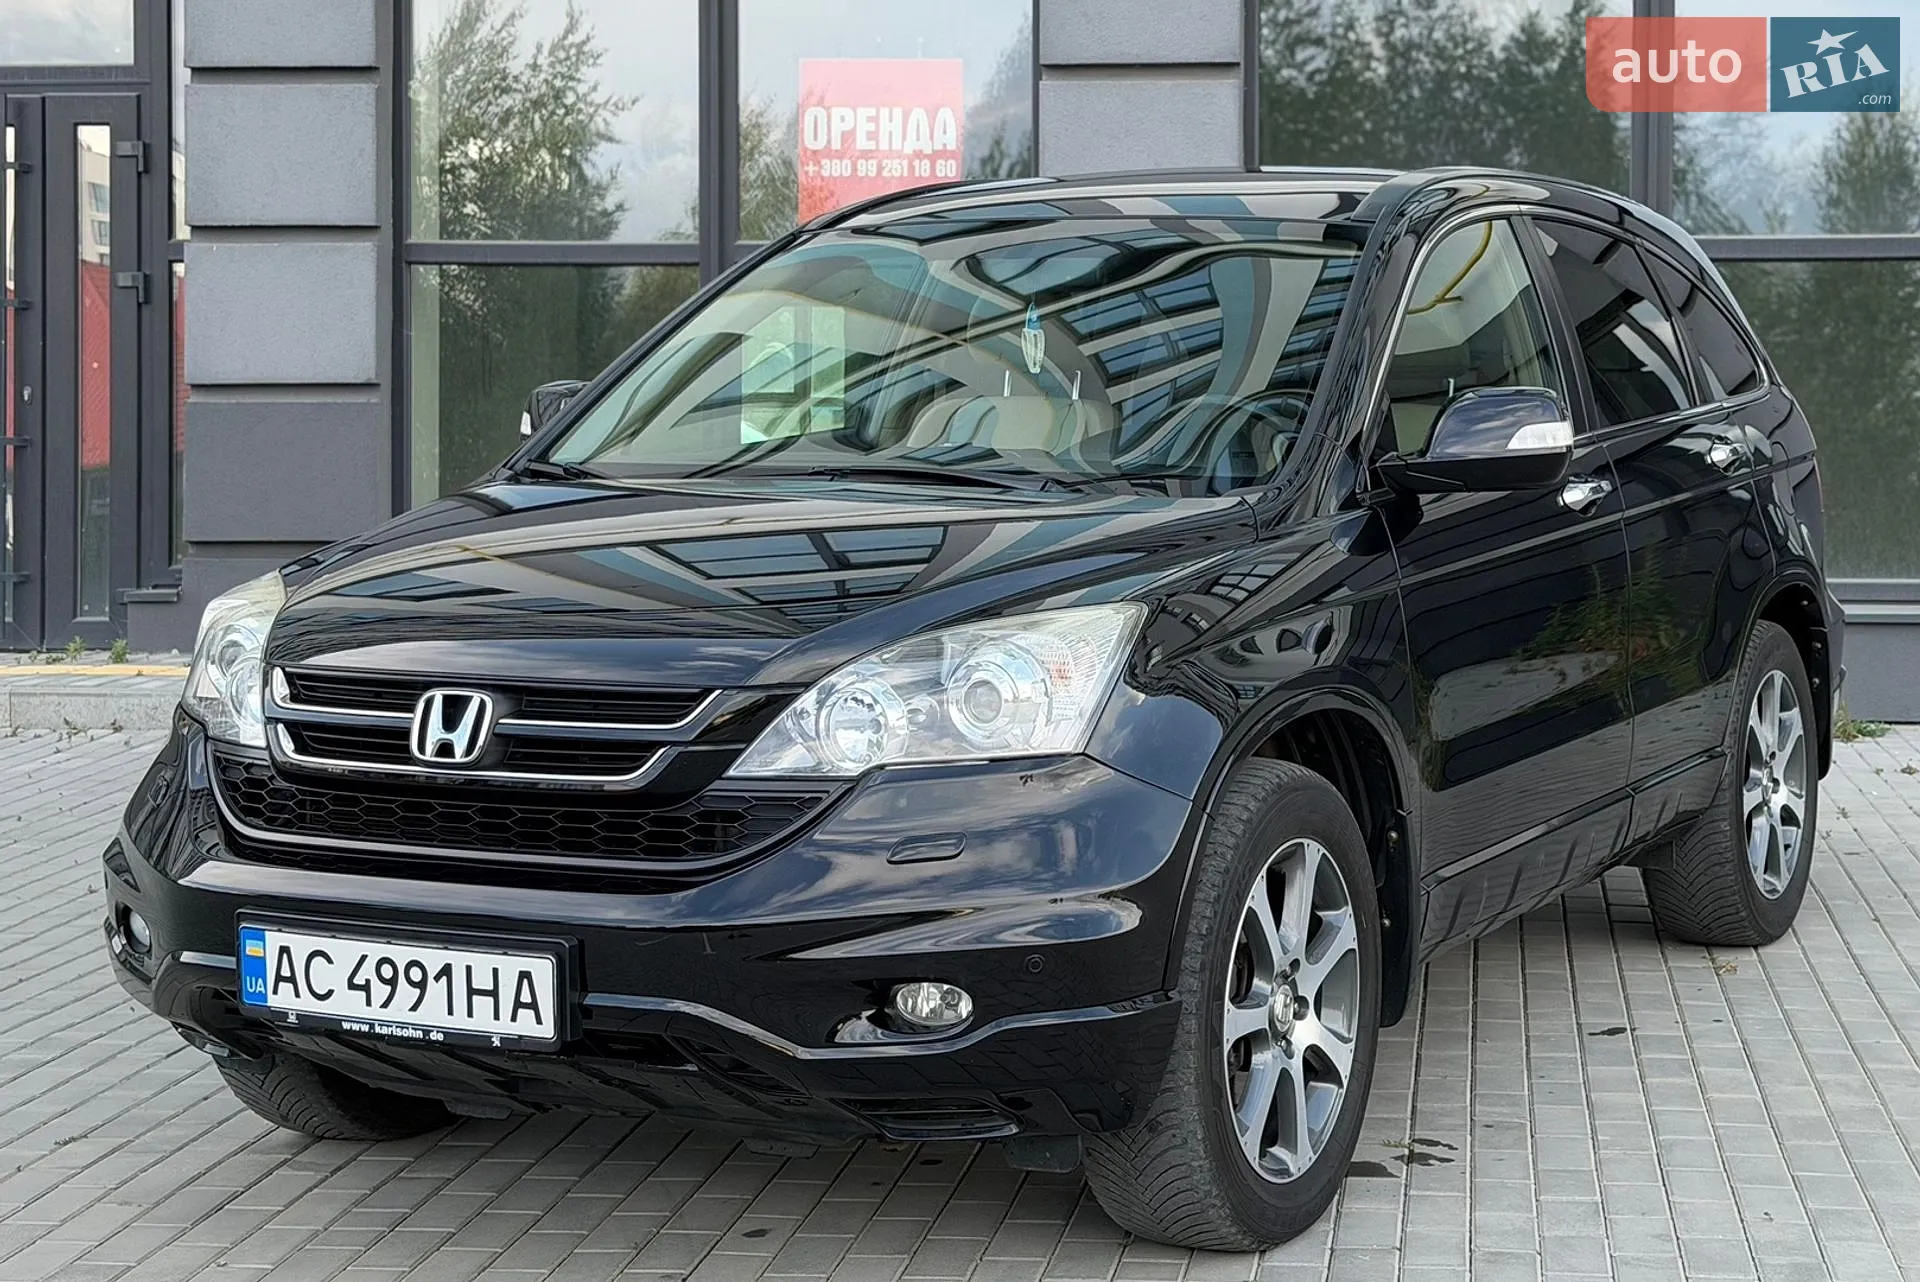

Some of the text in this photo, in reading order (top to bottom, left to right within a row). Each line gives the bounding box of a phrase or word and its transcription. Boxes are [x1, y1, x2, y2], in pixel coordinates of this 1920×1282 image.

[804, 106, 957, 154] ОРЕНДА
[804, 159, 852, 177] +380
[857, 159, 877, 177] 99
[882, 159, 909, 177] 251
[936, 159, 957, 177] 60
[246, 978, 266, 994] UA
